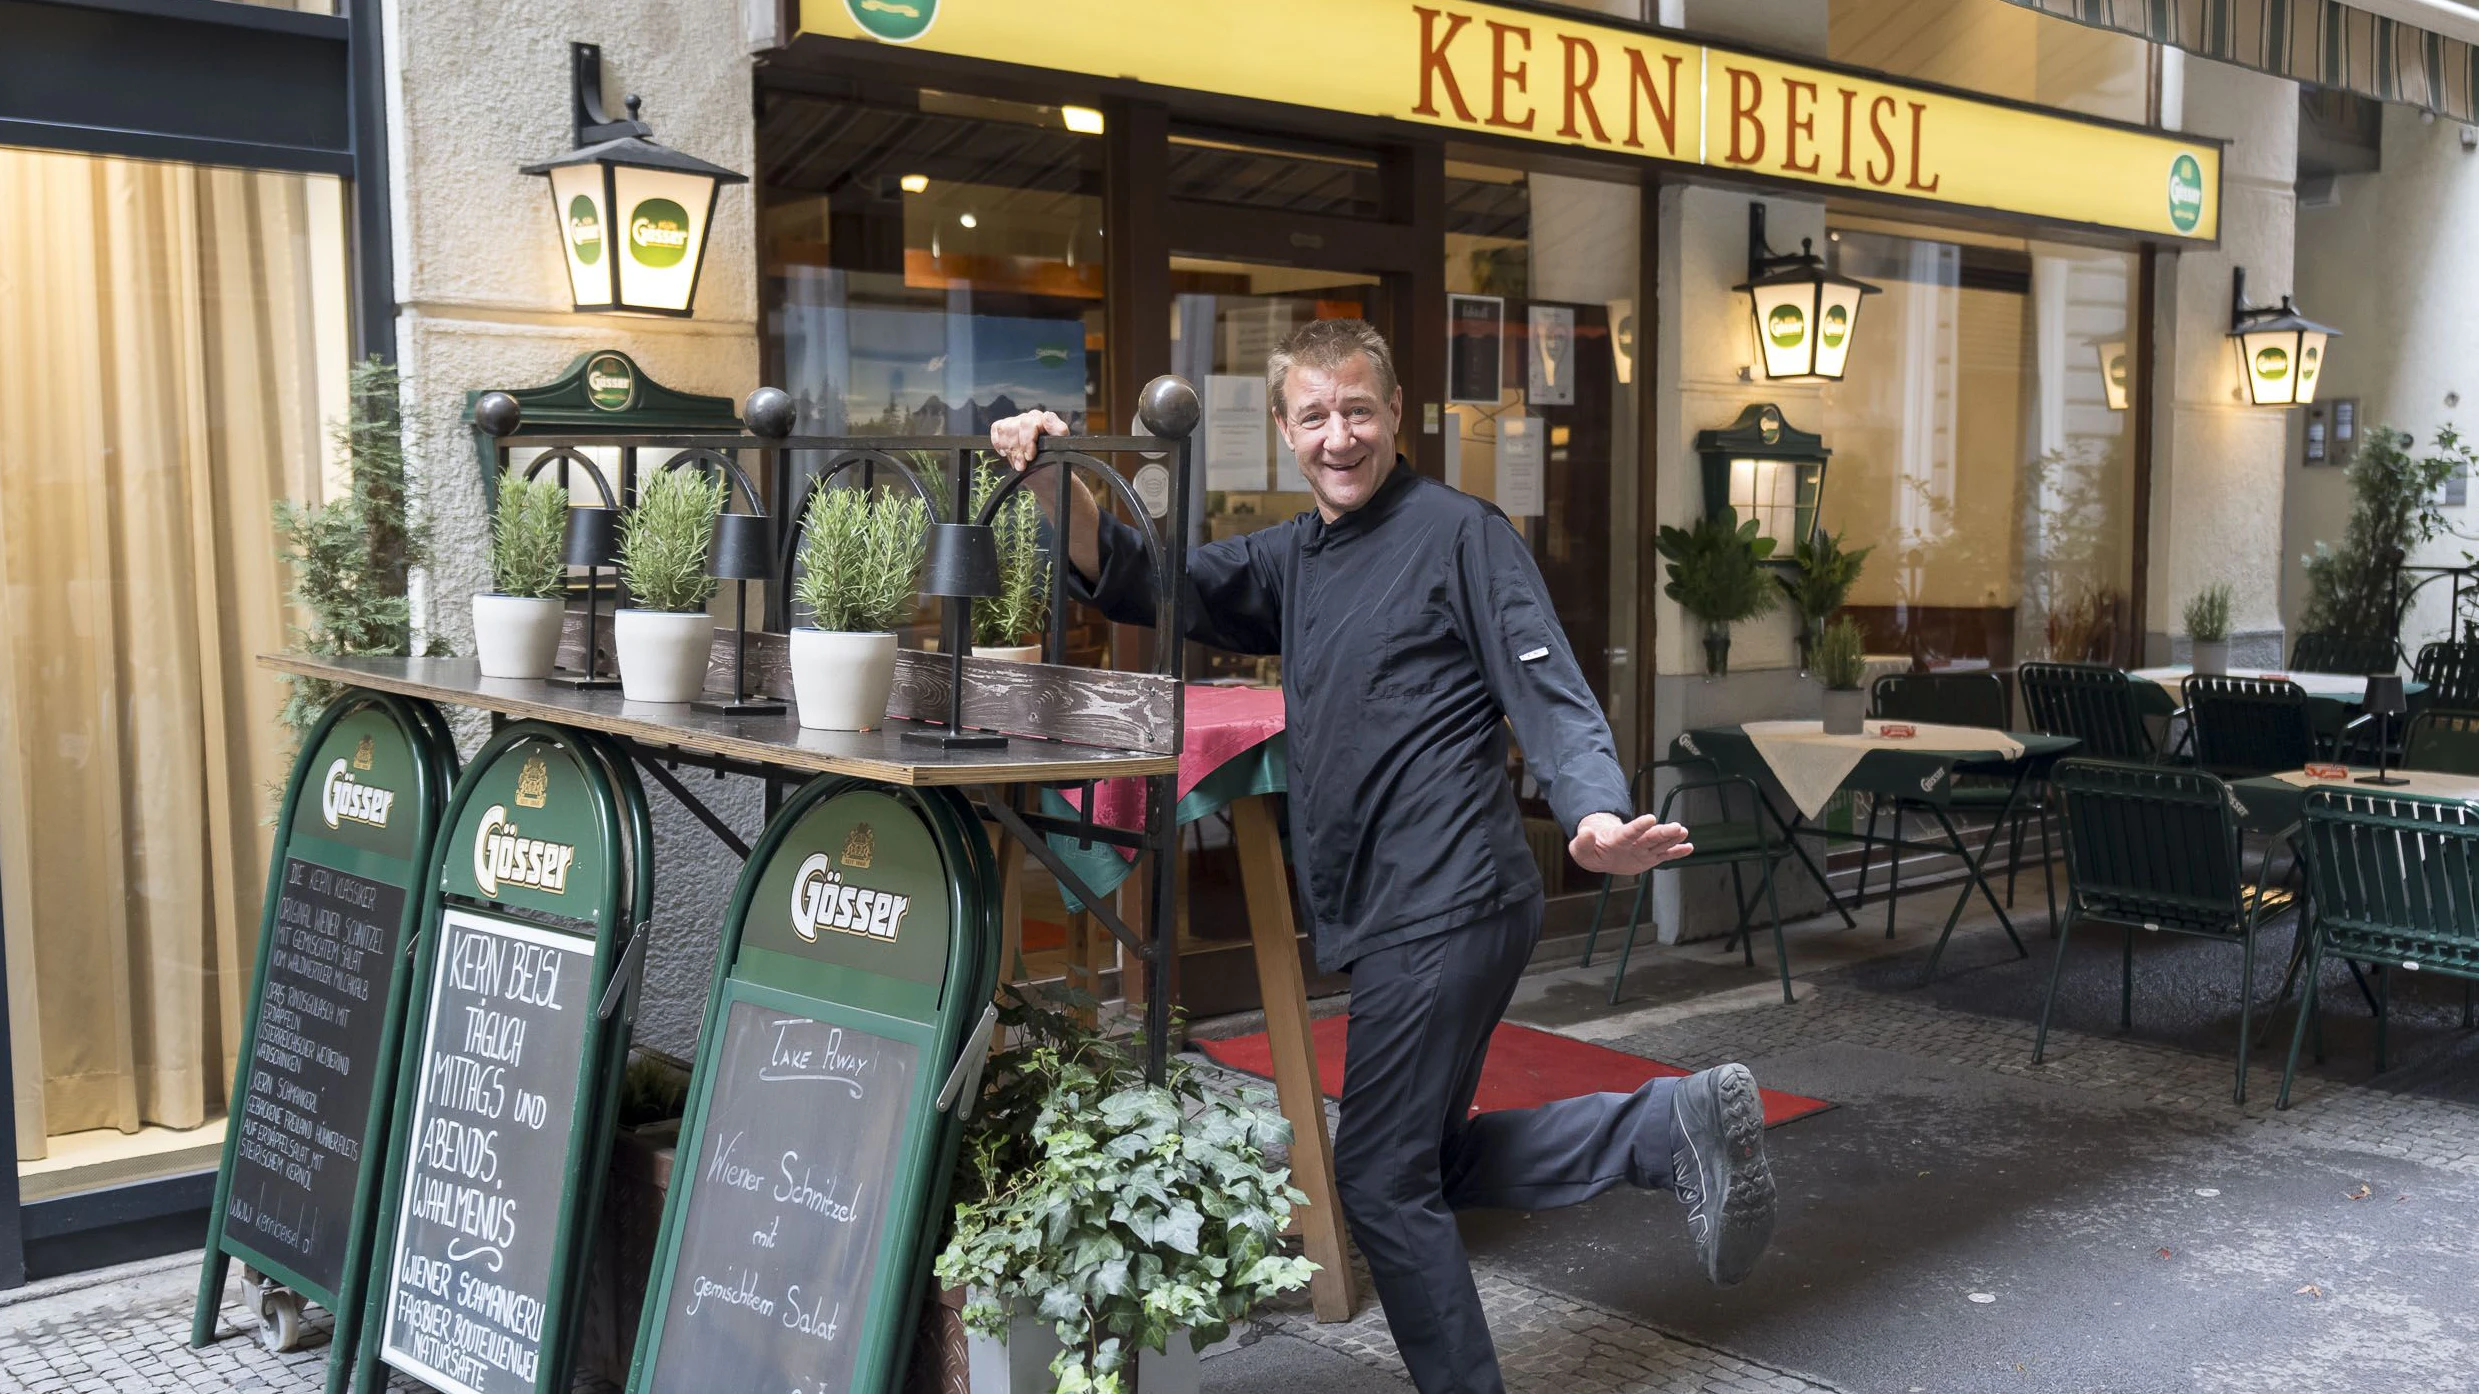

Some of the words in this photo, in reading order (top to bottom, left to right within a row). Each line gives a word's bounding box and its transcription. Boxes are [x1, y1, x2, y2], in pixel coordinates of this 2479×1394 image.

[1411, 5, 1682, 156] KERN
[1725, 66, 1940, 193] BEISL
[322, 757, 395, 830] Gösser
[473, 804, 574, 898] Gösser
[288, 863, 304, 885] DIE
[309, 869, 332, 897] KERN
[334, 876, 377, 911] KLASSIKER
[790, 852, 911, 944] Gösser
[276, 924, 293, 946] MIT
[293, 928, 338, 962] GEMISCHTEM
[341, 946, 364, 973] SALAT
[279, 898, 311, 928] ORIGINAL
[314, 907, 340, 936] WIENER
[344, 917, 384, 954] SCHNITZEL
[273, 950, 286, 968] VOM
[449, 931, 506, 997] KERN
[505, 942, 562, 1010] BEISL
[335, 1006, 352, 1027] MIT
[464, 998, 526, 1067] TÄGLICH
[253, 1071, 273, 1095] KERN
[277, 1077, 317, 1113] SCHMANKERL
[429, 1051, 505, 1119] MITTAGS
[514, 1088, 547, 1130] UND
[242, 1118, 256, 1136] AUF
[310, 1152, 325, 1171] MIT
[284, 1111, 313, 1140] FREILAND
[239, 1138, 284, 1175] STEIRISCHEM
[706, 1131, 765, 1191] Wiener
[774, 1150, 862, 1222] Schnitzel
[753, 1216, 779, 1248] mit
[401, 1247, 452, 1300] WIENER
[686, 1266, 774, 1317] gemischtem
[782, 1284, 839, 1341] Salat
[413, 1331, 488, 1392] NATURSÄFTE
